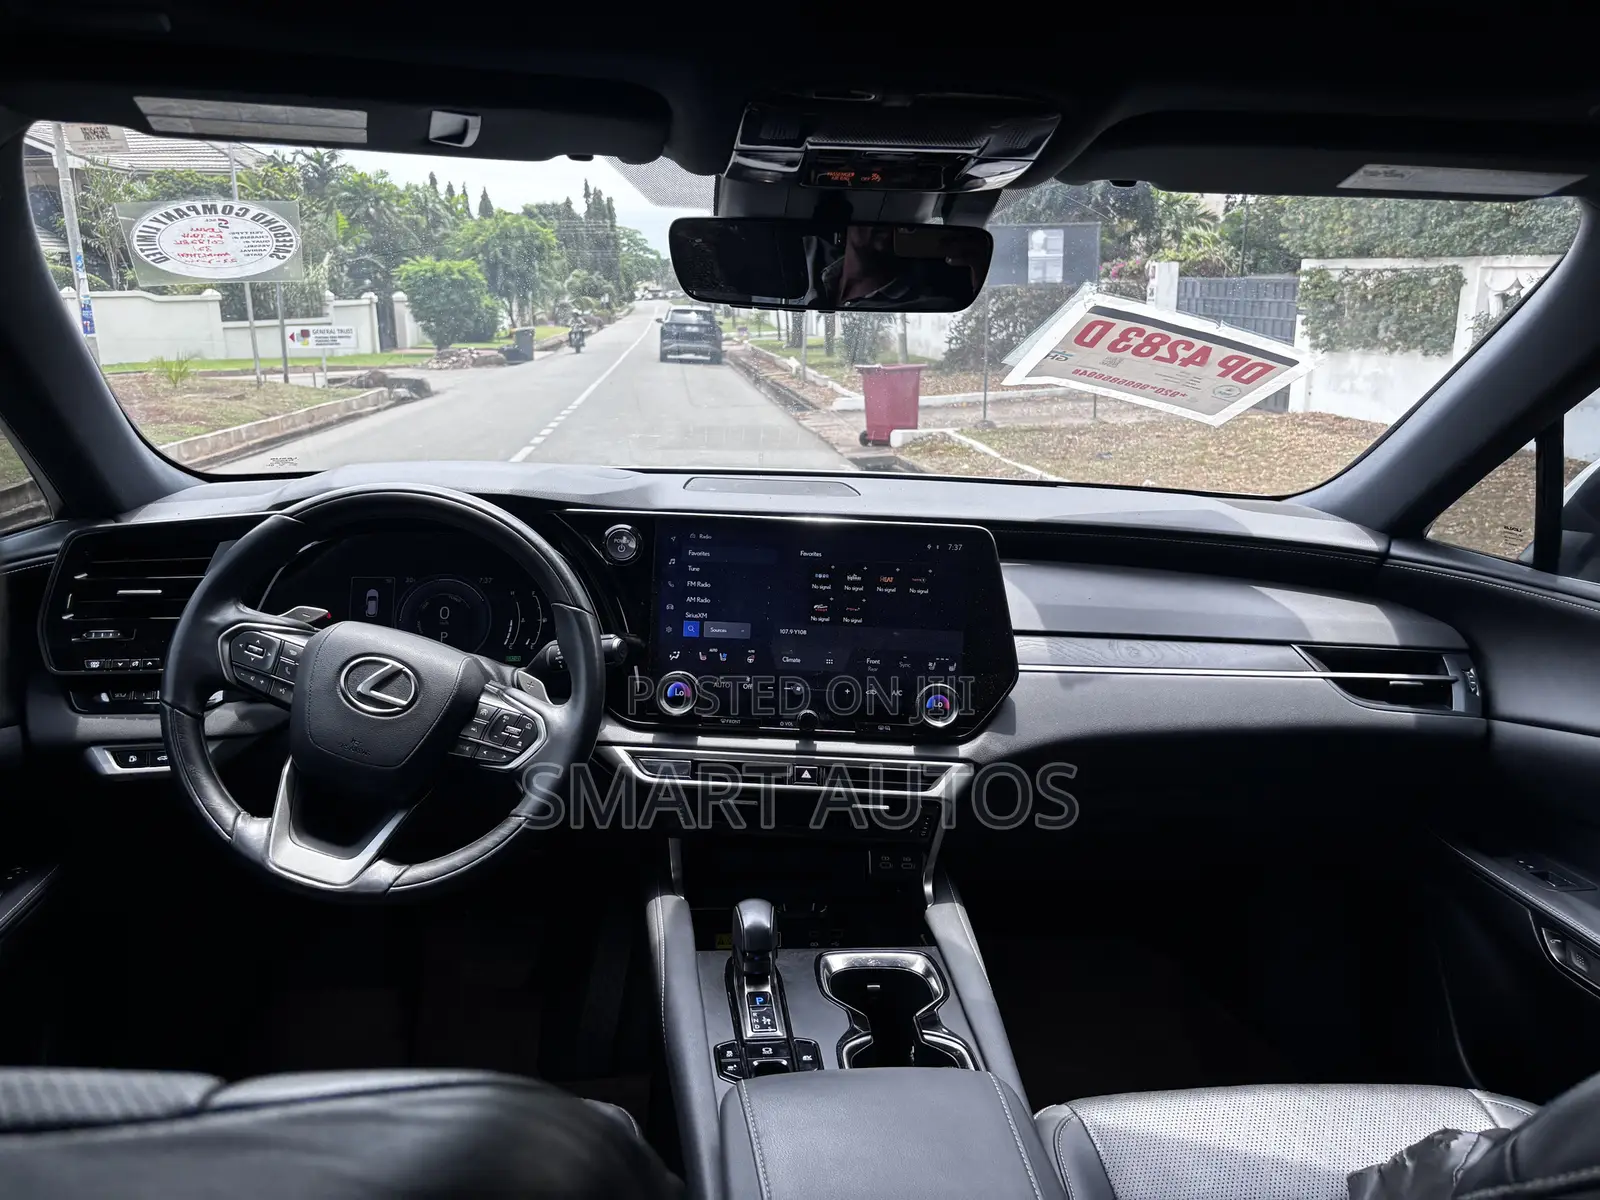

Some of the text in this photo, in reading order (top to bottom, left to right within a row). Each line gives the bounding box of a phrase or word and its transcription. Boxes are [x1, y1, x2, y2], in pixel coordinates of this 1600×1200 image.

[947, 543, 963, 551] 7:37
[688, 549, 711, 557] Favorites
[696, 596, 711, 604] Radio
[439, 606, 450, 620] 0
[440, 631, 449, 644] P
[866, 657, 881, 665] Front
[674, 689, 684, 697] Lo
[755, 997, 763, 1005] P
